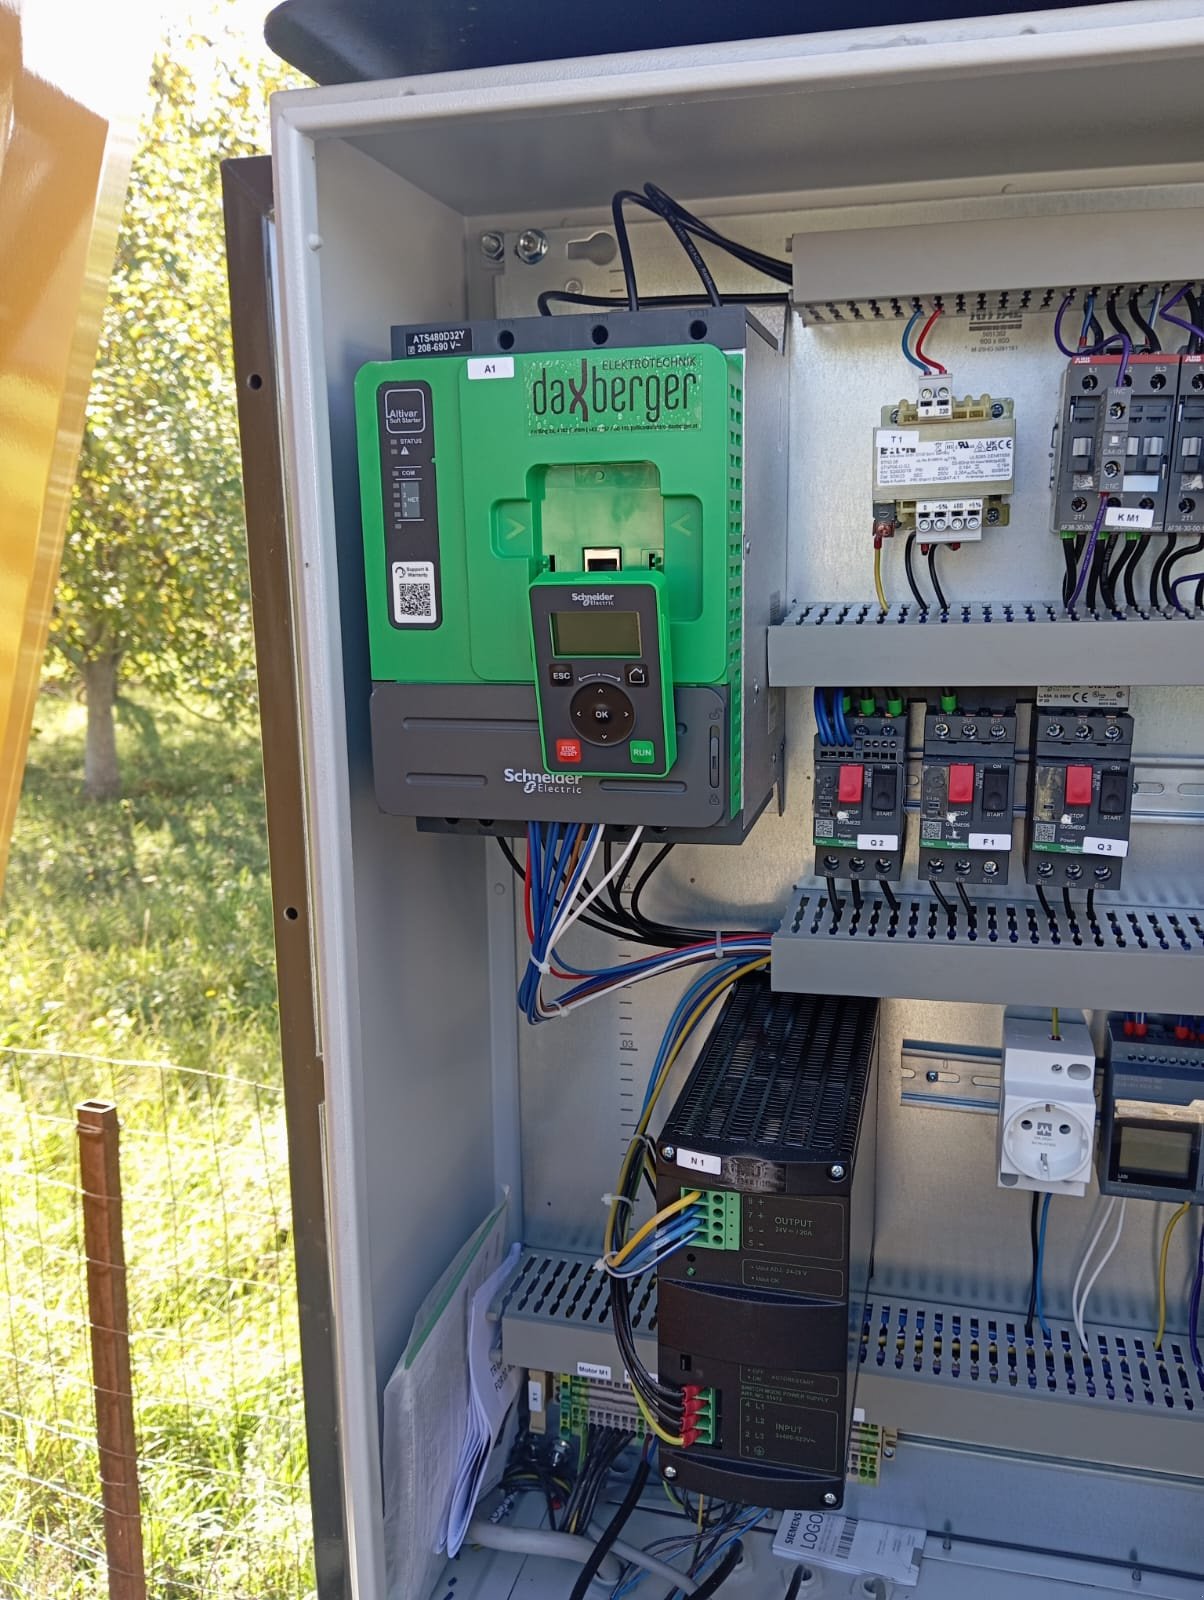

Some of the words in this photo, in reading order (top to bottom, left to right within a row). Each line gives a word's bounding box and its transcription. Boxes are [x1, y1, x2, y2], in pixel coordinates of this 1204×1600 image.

[413, 330, 465, 344] ATS480D32Y
[417, 342, 448, 353] 208-690
[602, 356, 697, 371] ELEKTROTECHNIK
[484, 364, 496, 374] A1
[532, 357, 697, 423] daxberger
[389, 409, 419, 418] Altivar
[571, 593, 615, 602] Schneider
[553, 672, 571, 680] ESC
[595, 710, 609, 719] OK
[633, 748, 652, 757] RUN
[503, 768, 583, 785] Schneider
[538, 783, 582, 794] Electric
[774, 1216, 814, 1228] OUTPUT
[578, 1366, 598, 1375] Motor
[775, 1423, 802, 1433] INPUT
[784, 1511, 803, 1545] SIEMENS
